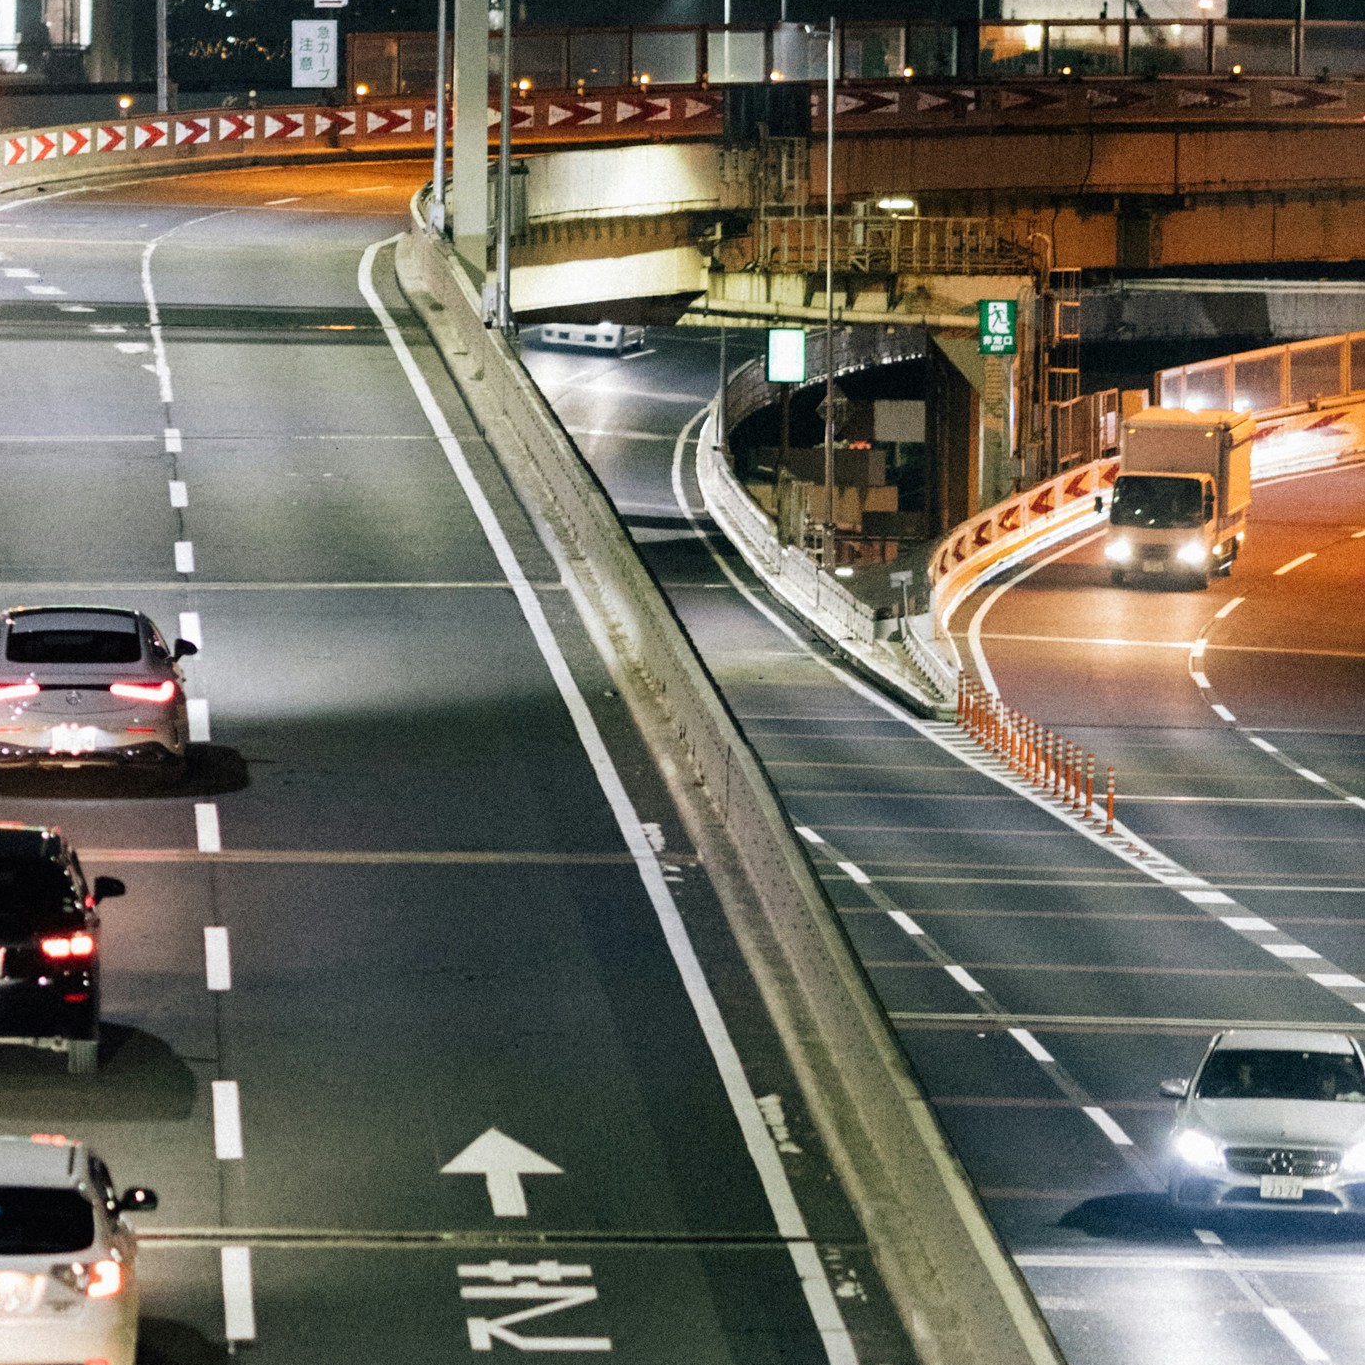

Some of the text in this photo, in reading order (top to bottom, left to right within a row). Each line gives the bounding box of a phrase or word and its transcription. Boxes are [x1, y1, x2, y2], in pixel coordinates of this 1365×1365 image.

[299, 37, 313, 71] 注意
[317, 26, 331, 82] 急カーブ
